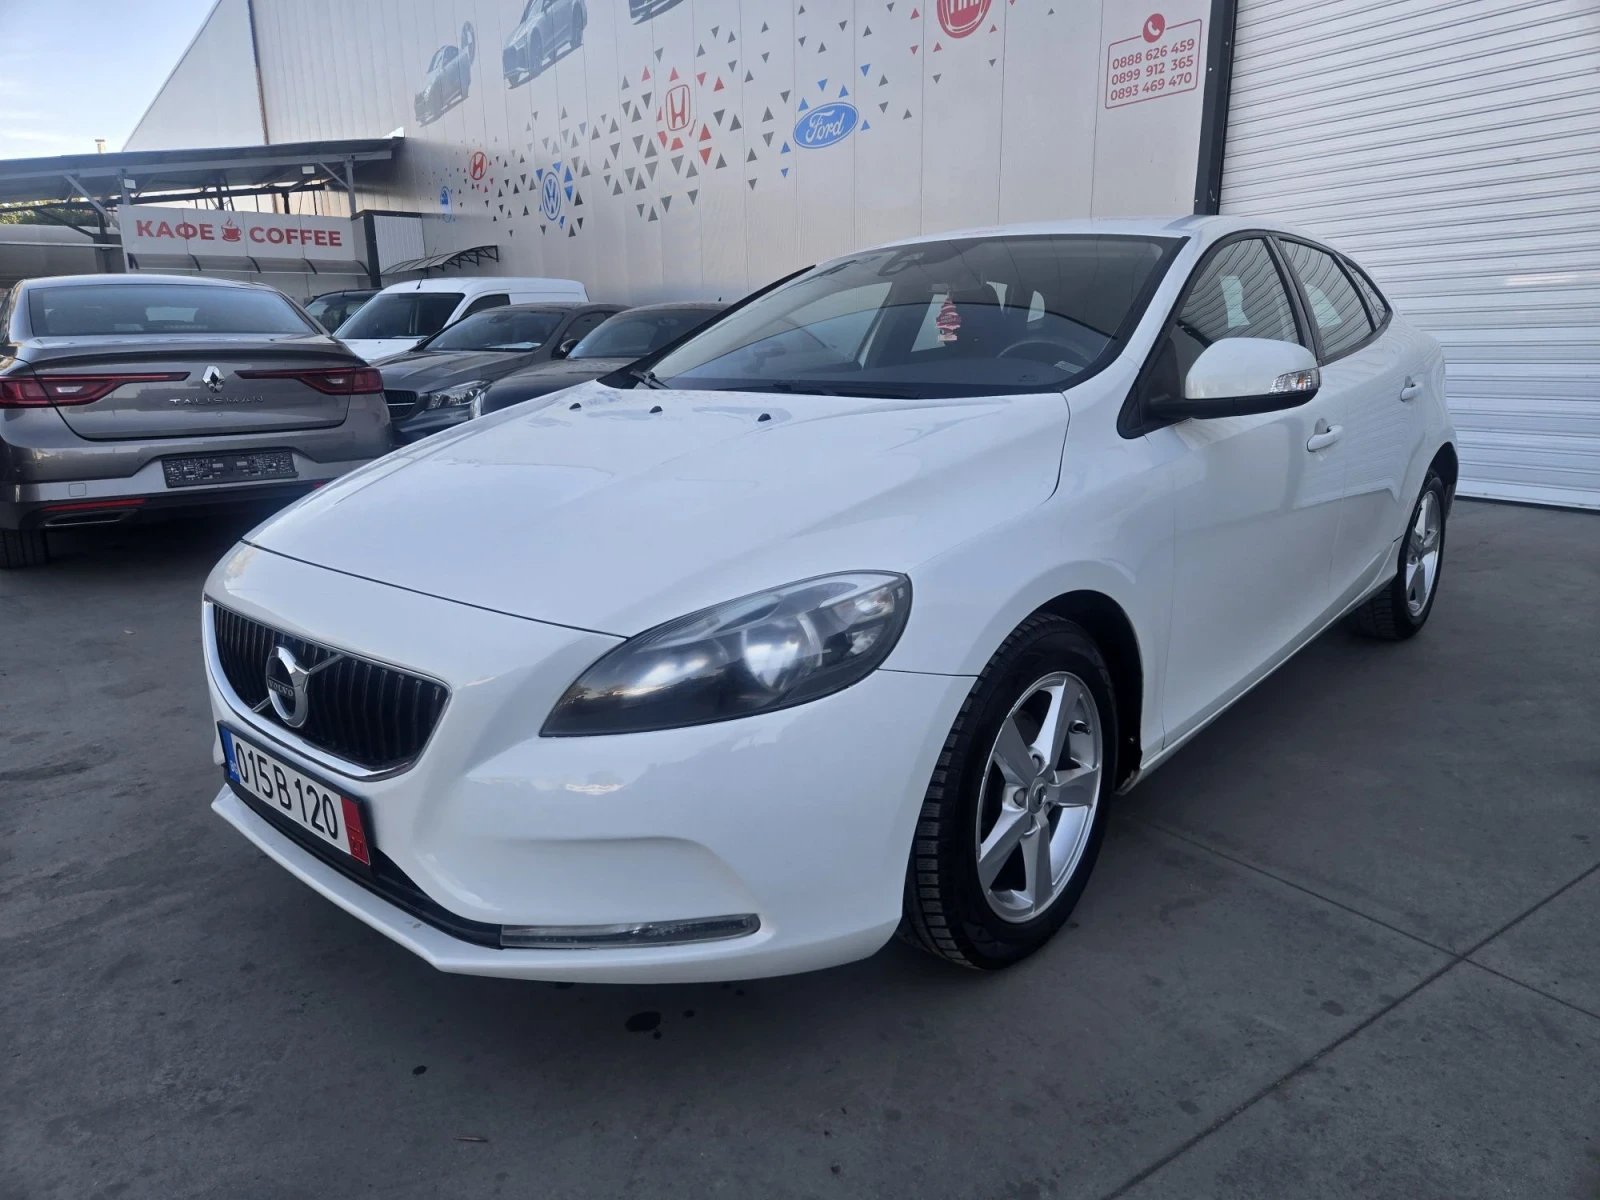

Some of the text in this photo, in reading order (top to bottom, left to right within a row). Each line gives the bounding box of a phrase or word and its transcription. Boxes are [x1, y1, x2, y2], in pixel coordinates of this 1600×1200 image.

[1112, 38, 1195, 70] 0888 626 459
[1111, 55, 1194, 85] 0899 912 365
[1110, 71, 1192, 100] 0893 469 470
[805, 109, 846, 143] Ford
[136, 219, 215, 241] КАФЕ
[249, 226, 343, 247] COFFEE
[268, 679, 294, 698] VOLVO
